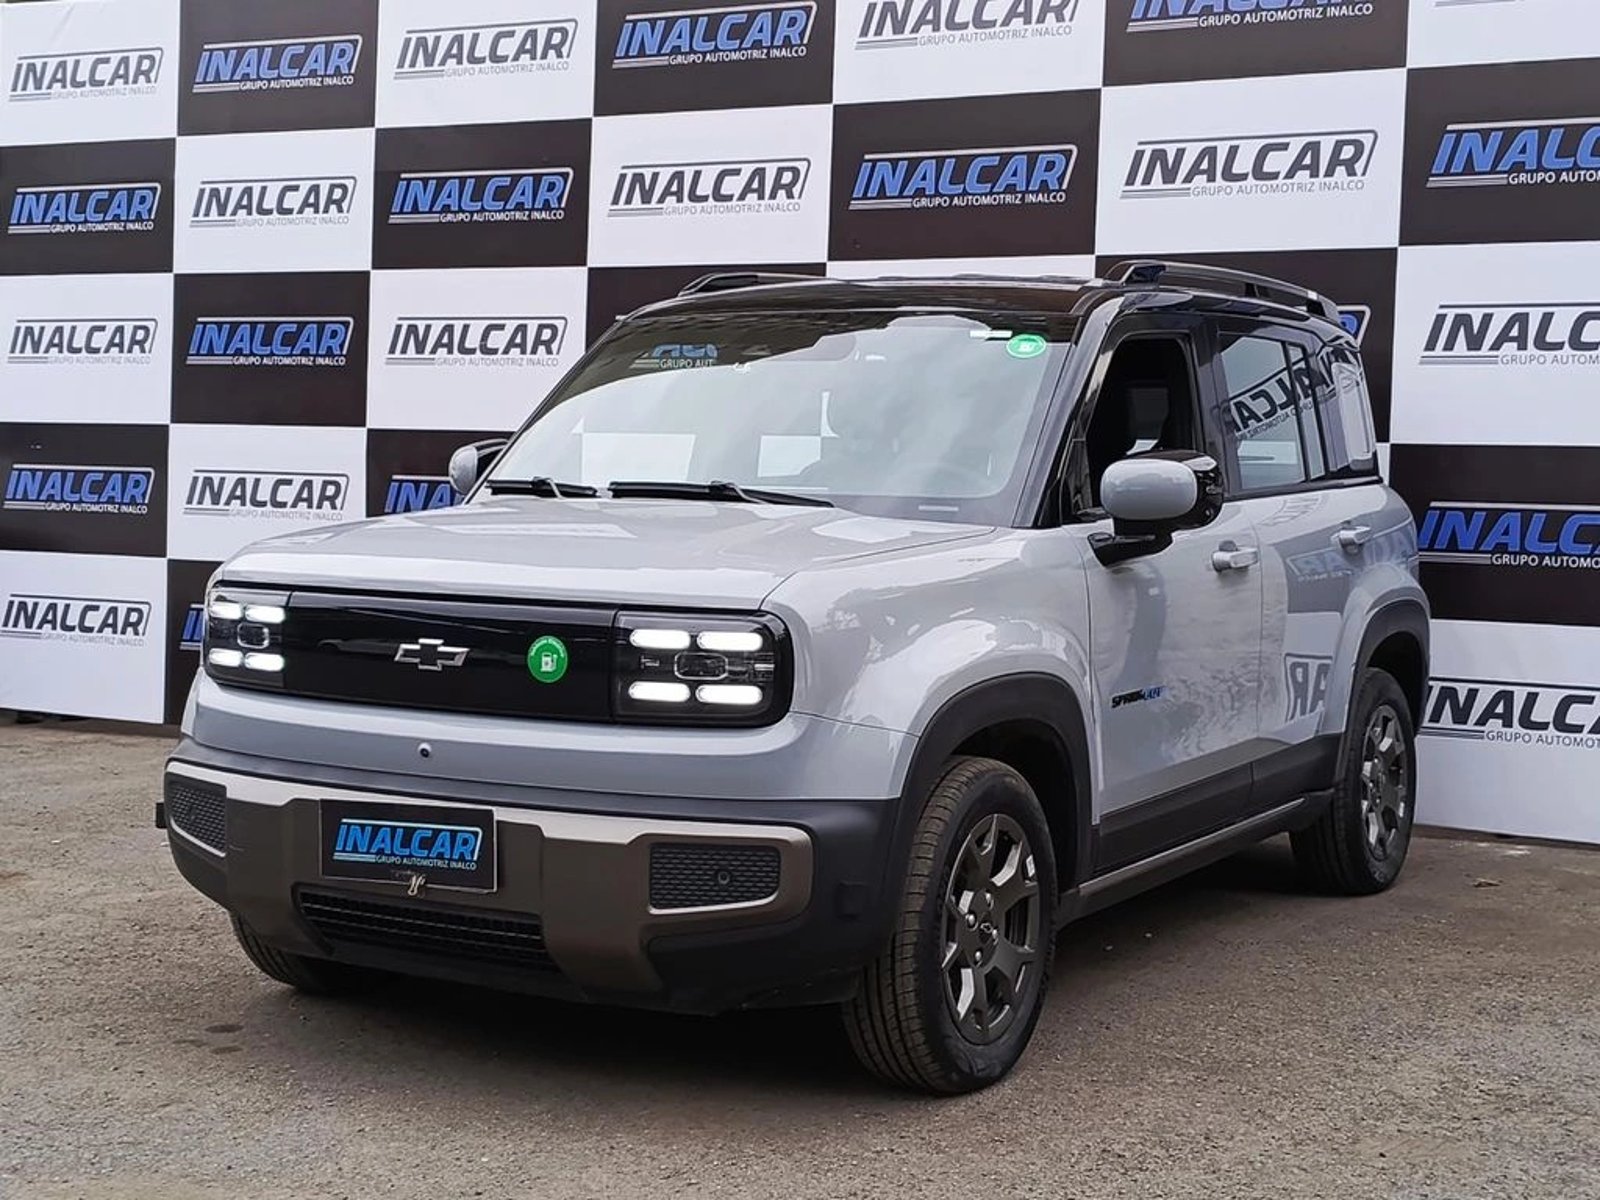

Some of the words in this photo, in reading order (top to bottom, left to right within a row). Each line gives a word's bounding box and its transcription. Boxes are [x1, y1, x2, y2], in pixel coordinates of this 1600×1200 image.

[858, 0, 1067, 38] INALCAR
[1199, 15, 1241, 28] GRUPO
[1243, 8, 1323, 24] AUTOMOTRIZ
[1326, 3, 1373, 17] INALCO
[396, 26, 569, 69] INALCAR
[615, 9, 807, 57] INALCAR
[918, 34, 956, 46] GRUPO
[958, 29, 1028, 44] AUTOMOTRIZ
[1031, 25, 1073, 37] INALCO
[195, 41, 354, 82] INALCAR
[444, 66, 476, 78] GRUPO
[477, 63, 533, 75] AUTOMOTRIZ
[535, 61, 569, 71] INALCO
[670, 54, 703, 65] GRUPO
[705, 49, 767, 63] AUTOMOTRIZ
[770, 46, 807, 58] INALCO
[11, 54, 156, 92] INALCAR
[240, 80, 268, 91] GRUPO
[270, 77, 322, 89] AUTOMOTRIZ
[323, 75, 354, 86] INALCO
[852, 153, 1067, 198] INALCAR
[1124, 138, 1365, 187] INALCAR
[610, 166, 801, 205] INALCAR
[1191, 185, 1234, 197] GRUPO
[1236, 182, 1317, 196] AUTOMOTRIZ
[1319, 180, 1365, 192] INALCO
[1509, 171, 1556, 185] GRUPO
[10, 190, 153, 224] INALCAR
[192, 183, 349, 218] INALCAR
[391, 175, 565, 213] INALCAR
[663, 205, 698, 216] GRUPO
[700, 203, 762, 215] AUTOMOTRIZ
[764, 202, 801, 214] INALCO
[913, 196, 949, 208] GRUPO
[952, 193, 1022, 207] AUTOMOTRIZ
[1025, 192, 1067, 204] INALCO
[50, 224, 76, 233] GRUPO
[77, 222, 125, 232] AUTOMOTRIZ
[126, 221, 154, 231] INALCO
[236, 218, 264, 228] GRUPO
[265, 217, 317, 227] AUTOMOTRIZ
[318, 215, 349, 225] INALCO
[440, 212, 470, 223] GRUPO
[472, 211, 529, 222] AUTOMOTRIZ
[530, 210, 565, 220] INALCO
[9, 325, 150, 354] INALCAR
[189, 323, 346, 354] INALCAR
[388, 323, 559, 355] INALCAR
[233, 356, 261, 365] GRUPO
[262, 356, 314, 366] AUTOMOTRIZ
[315, 356, 346, 366] INALCO
[436, 357, 466, 367] GRUPO
[468, 357, 524, 367] AUTOMOTRIZ
[526, 357, 559, 367] INALCO
[1501, 354, 1547, 365] GRUPO
[1551, 354, 1600, 365] AUTOM
[5, 471, 148, 503] INALCAR
[186, 476, 342, 510] INALCAR
[384, 482, 464, 513] INA
[45, 502, 71, 512] GRUPO
[72, 503, 119, 513] AUTOMOTRIZ
[120, 504, 148, 514] INALCO
[1418, 510, 1600, 555] INALC
[1492, 554, 1539, 567] GRUPO
[1542, 555, 1600, 569] AUTOMO
[2, 600, 144, 636] INALCAR
[1427, 685, 1600, 735] NALC
[1486, 730, 1532, 744] GRUPO
[335, 824, 476, 860] INALCAR
[376, 856, 401, 866] GRUPO
[402, 858, 448, 868] AUTOMOTRIZ
[450, 861, 477, 871] INALCO
